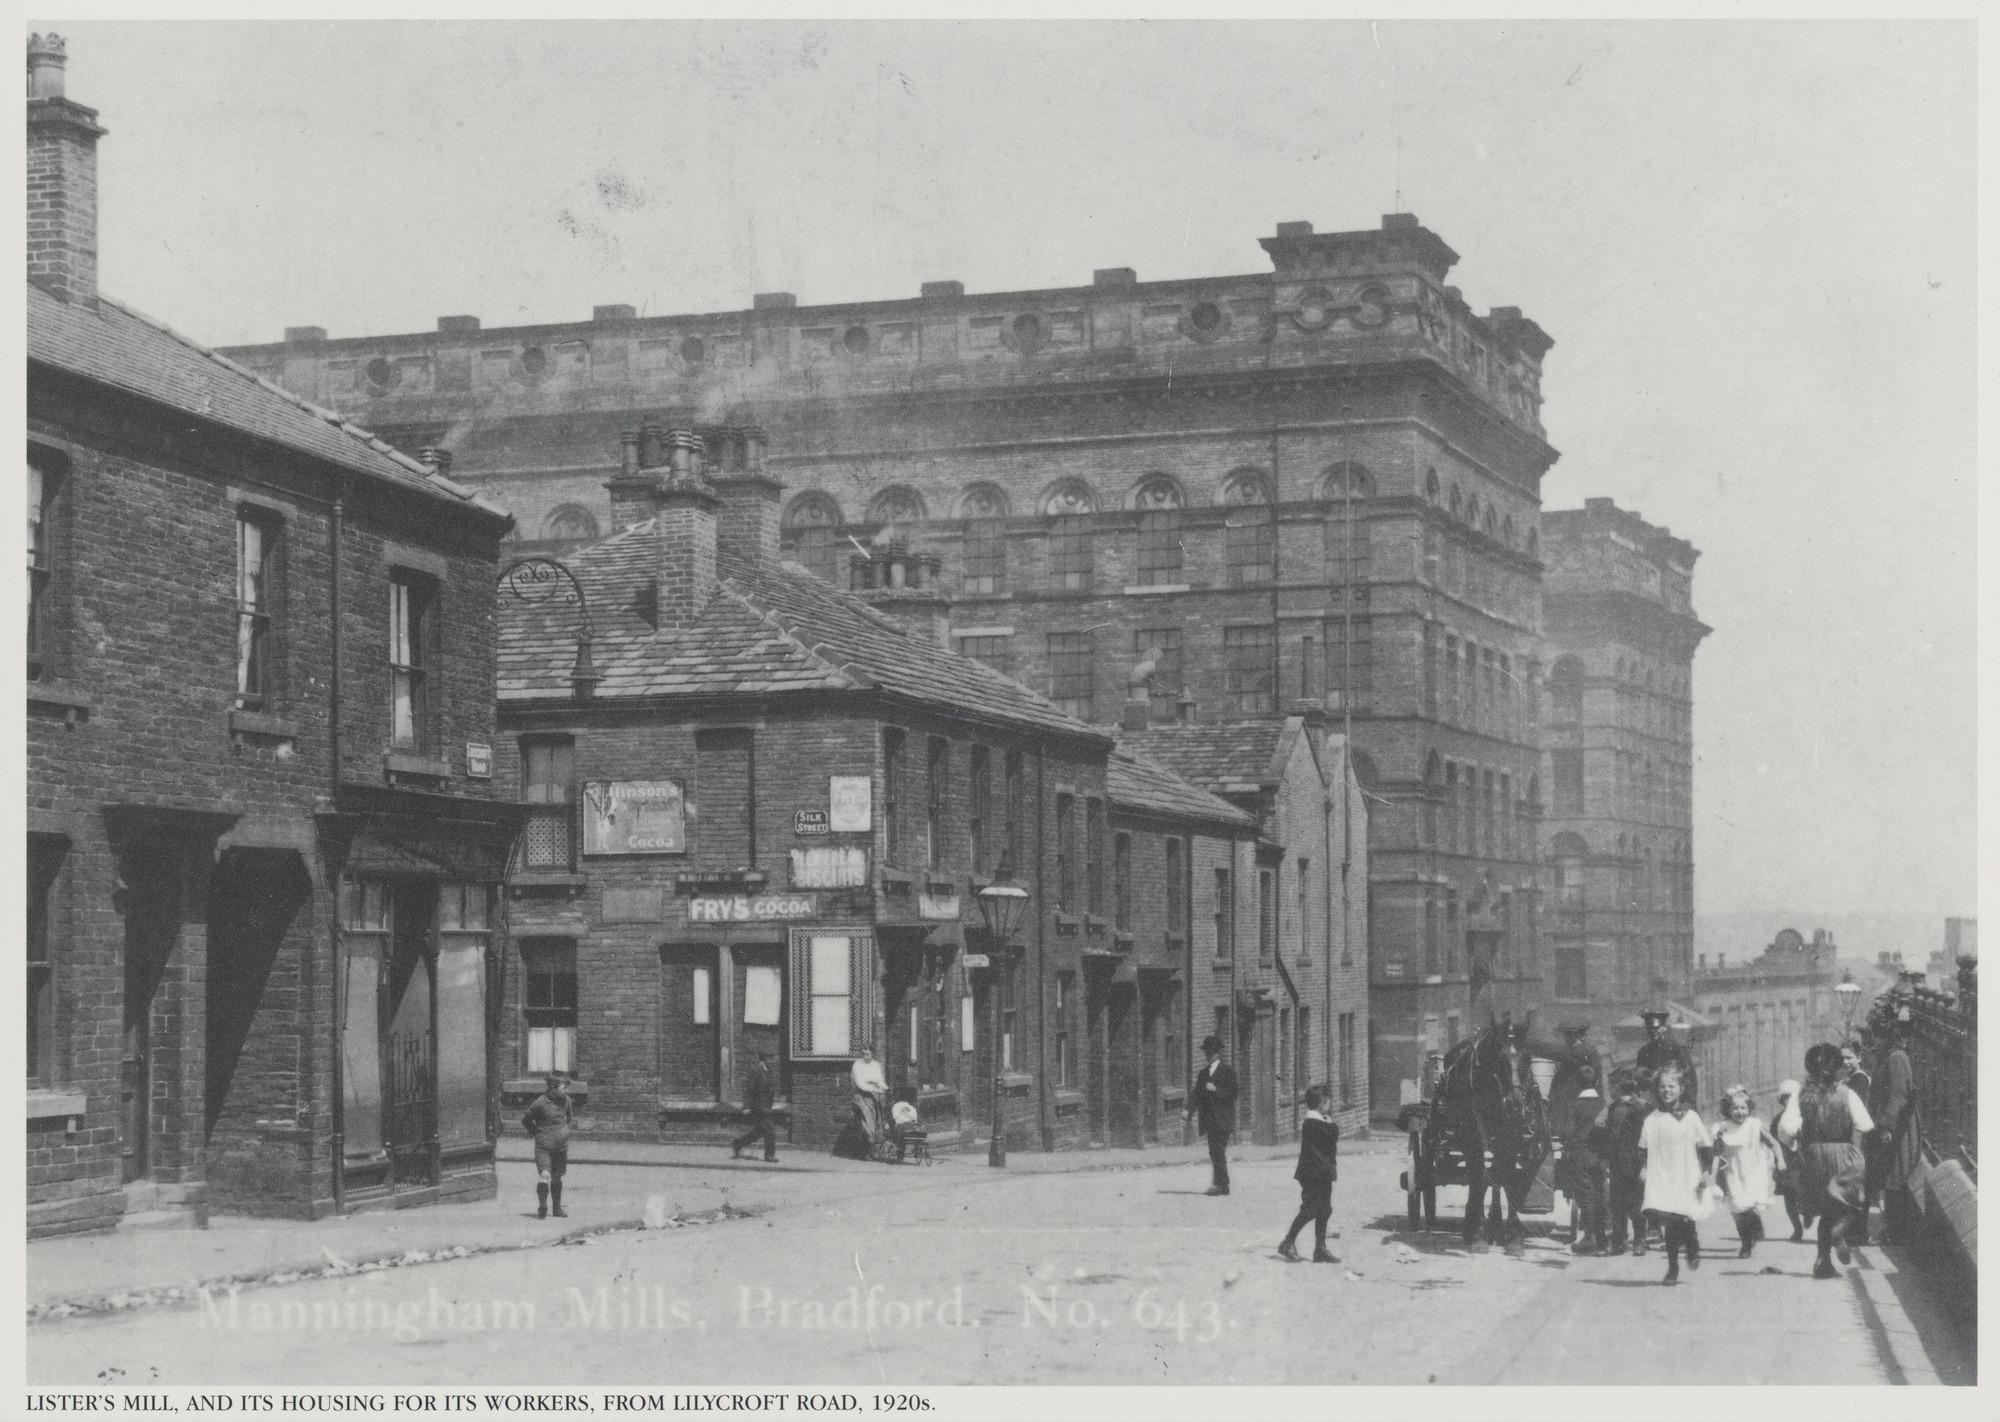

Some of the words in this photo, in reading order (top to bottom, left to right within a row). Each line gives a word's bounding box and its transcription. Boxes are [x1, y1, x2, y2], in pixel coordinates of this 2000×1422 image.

[799, 811, 822, 822] SILK
[797, 823, 826, 833] STREET
[628, 835, 674, 849] Cocoa
[753, 900, 811, 914] COCOA
